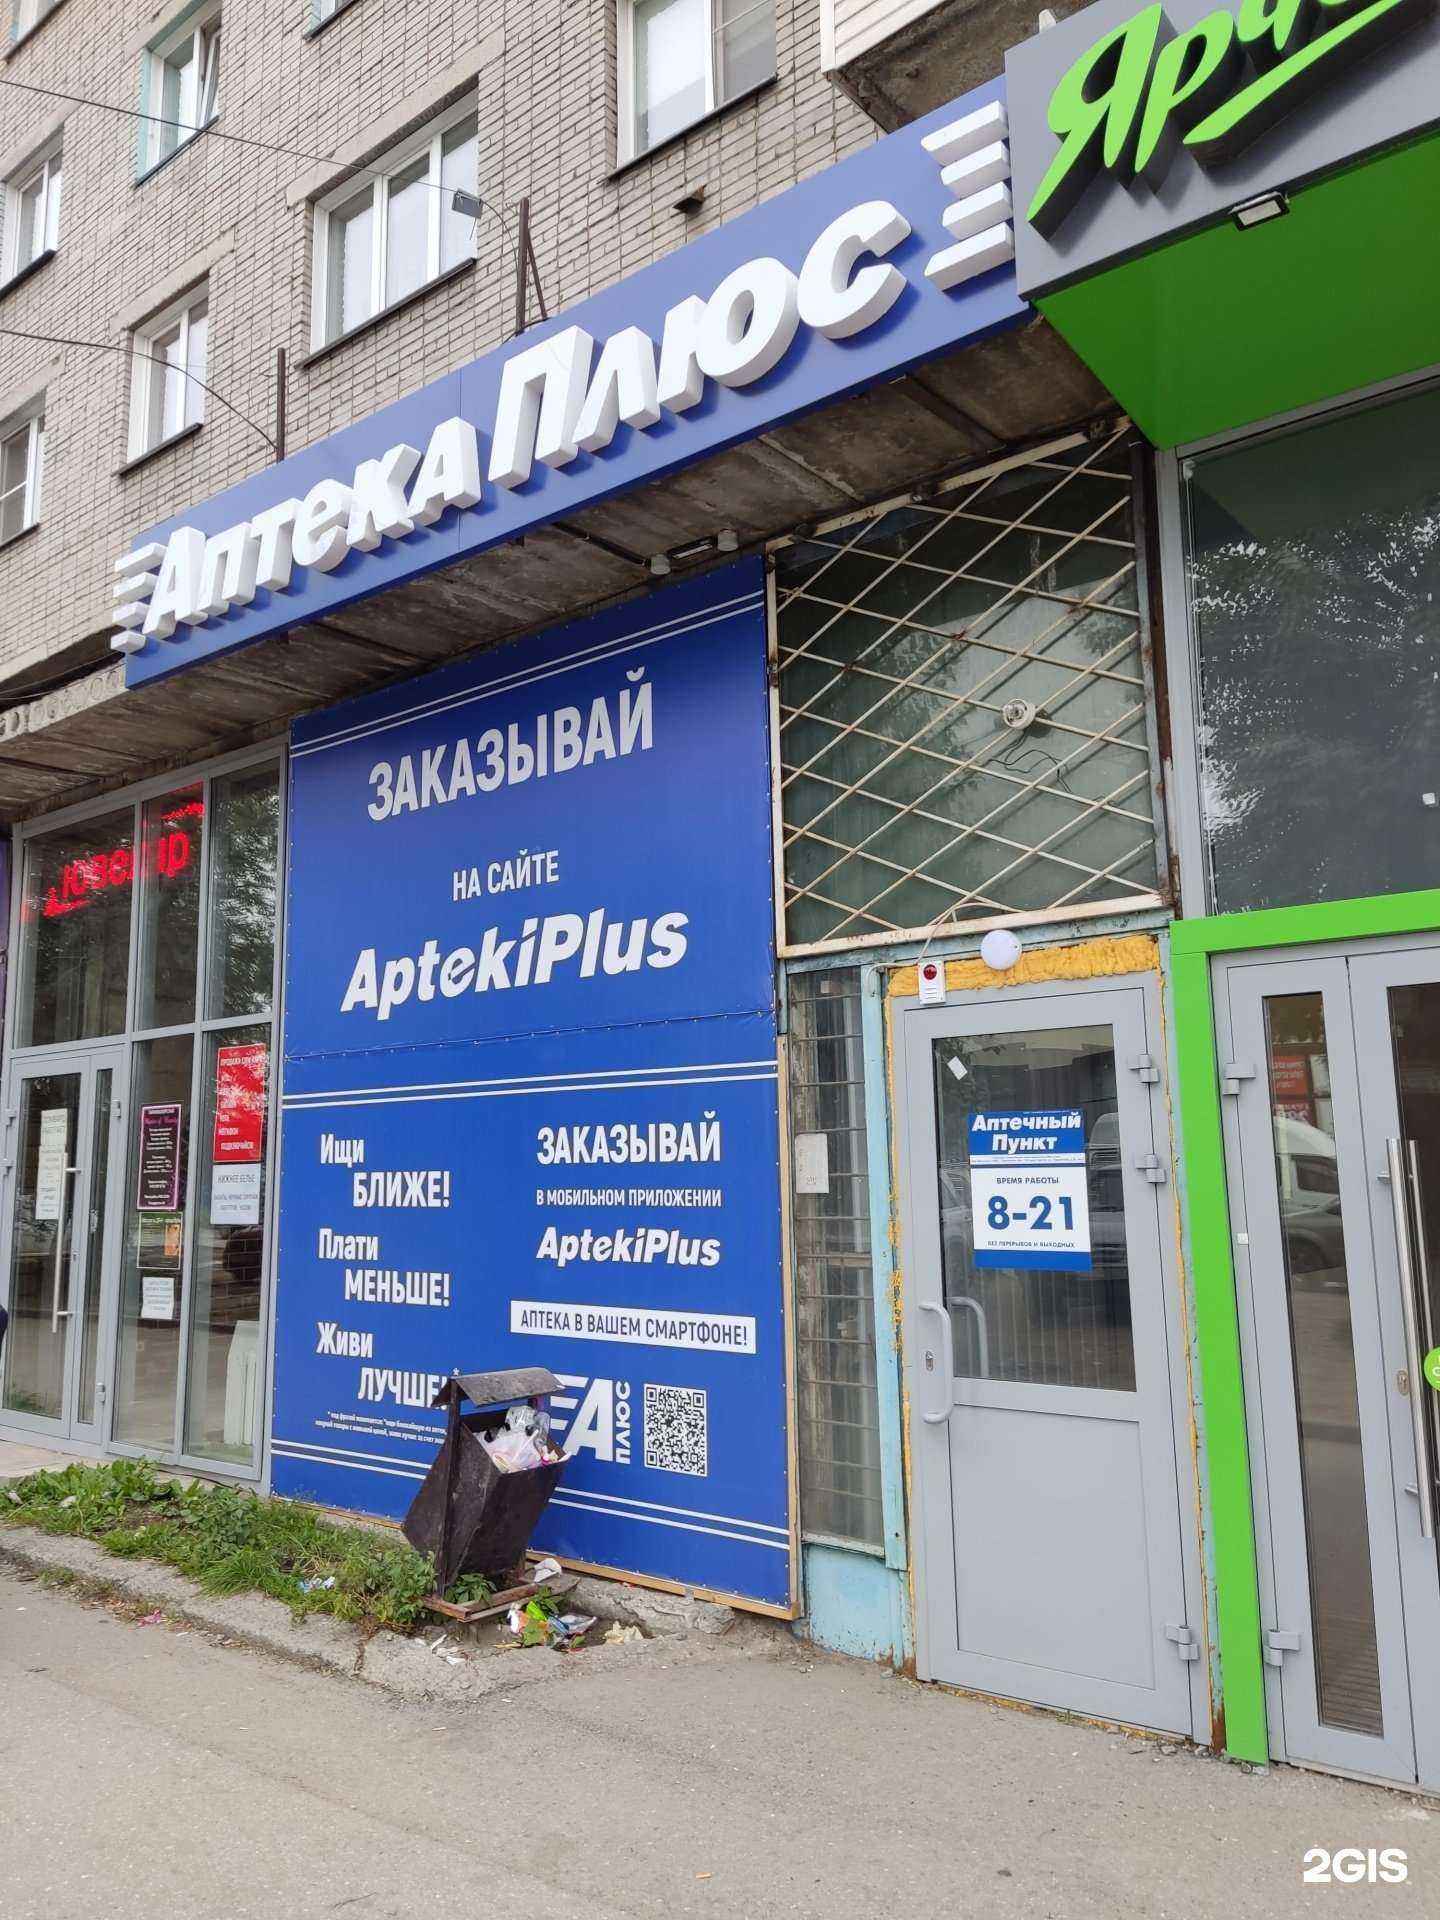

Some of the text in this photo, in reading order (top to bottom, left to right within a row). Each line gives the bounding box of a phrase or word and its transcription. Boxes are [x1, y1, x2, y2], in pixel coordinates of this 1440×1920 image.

[142, 200, 912, 640] Аптека Плюс
[367, 665, 654, 822] ЗАКАЗЫВАЙ
[453, 849, 559, 901] НА САЙТЕ
[340, 908, 689, 1021] AptekiPlus
[537, 1111, 721, 1164] ЗАКАЗЫВАЙ
[971, 1111, 1082, 1132] Аптечный
[319, 1133, 365, 1168] Ищи
[991, 1133, 1058, 1155] Пункт
[353, 1171, 451, 1208] БЛИЖЕ!
[536, 1188, 722, 1208] В МОБИЛЬНОМ ПРИЛОЖЕНИИ
[996, 1176, 1060, 1185] ВРЕМЯ РАБОТЫ
[987, 1195, 1074, 1231] 8-21
[318, 1228, 379, 1261] Плати
[536, 1226, 721, 1268] AptekiPlus
[344, 1269, 450, 1307] МЕНЬШЕ!
[315, 1322, 373, 1358] Живи
[520, 1309, 749, 1347] АПТЕКА В ВАШЕМ СМАРТФОНЕ!
[615, 1380, 632, 1465] ПЛЮС
